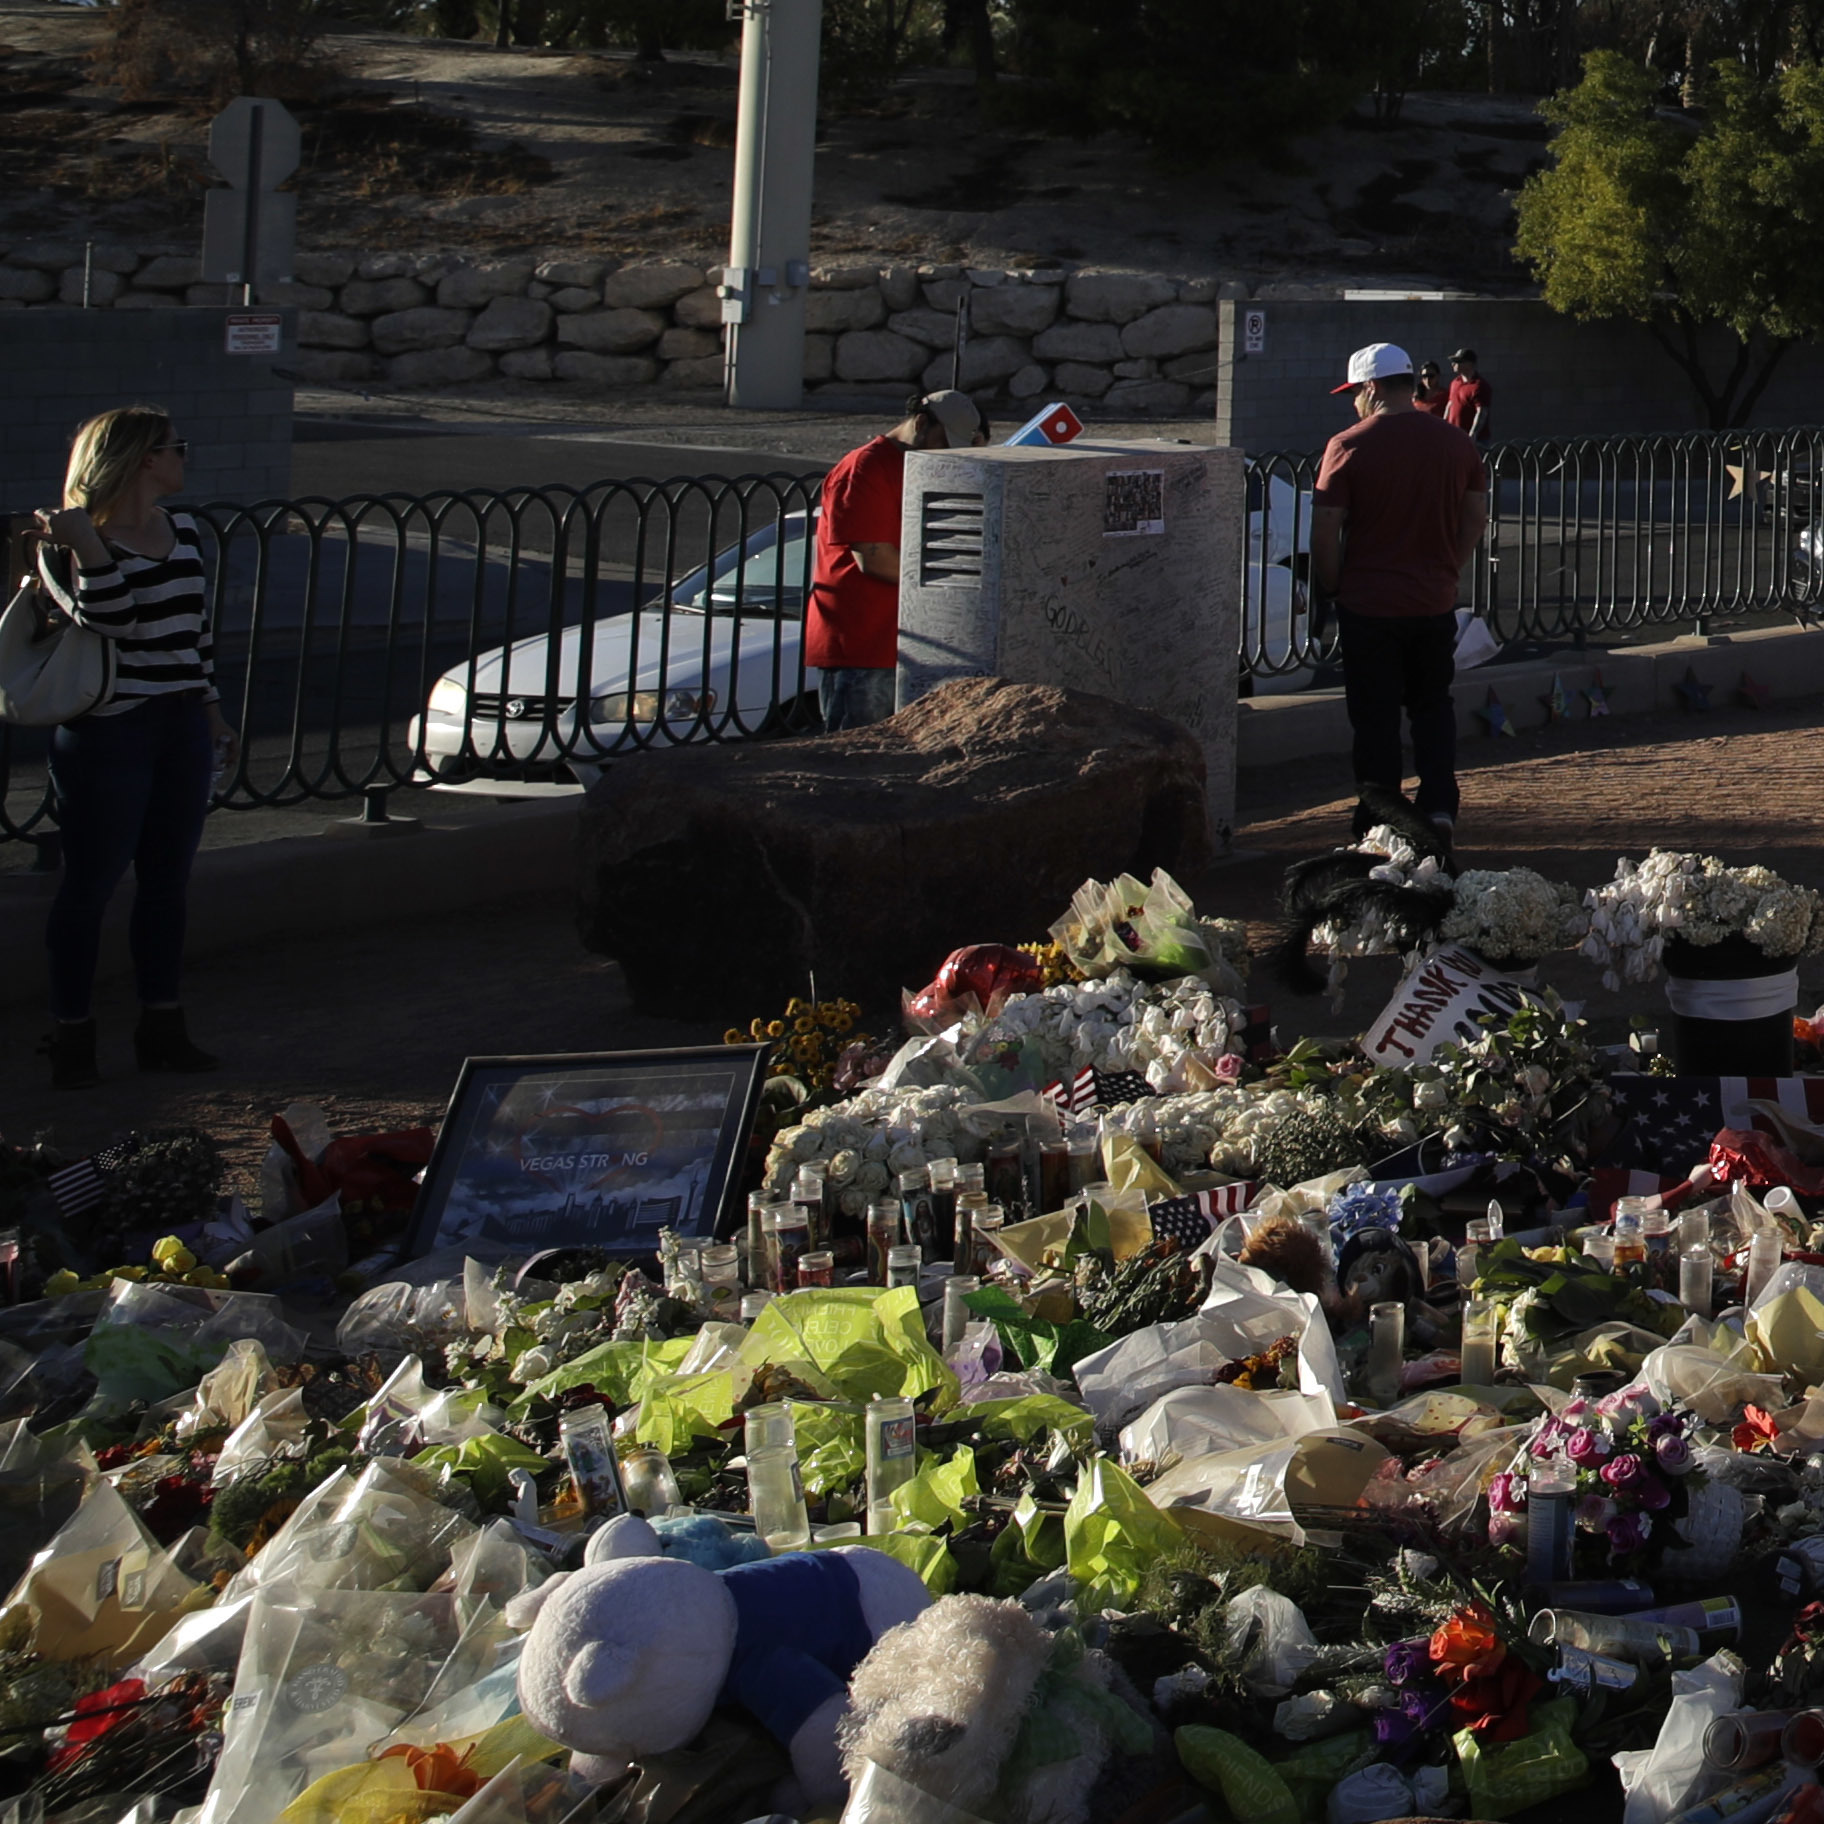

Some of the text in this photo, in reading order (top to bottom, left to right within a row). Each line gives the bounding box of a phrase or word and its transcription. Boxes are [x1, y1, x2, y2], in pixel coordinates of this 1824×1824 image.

[1375, 964, 1469, 1058] THANK
[519, 1151, 648, 1172] VEGAS STRNG
